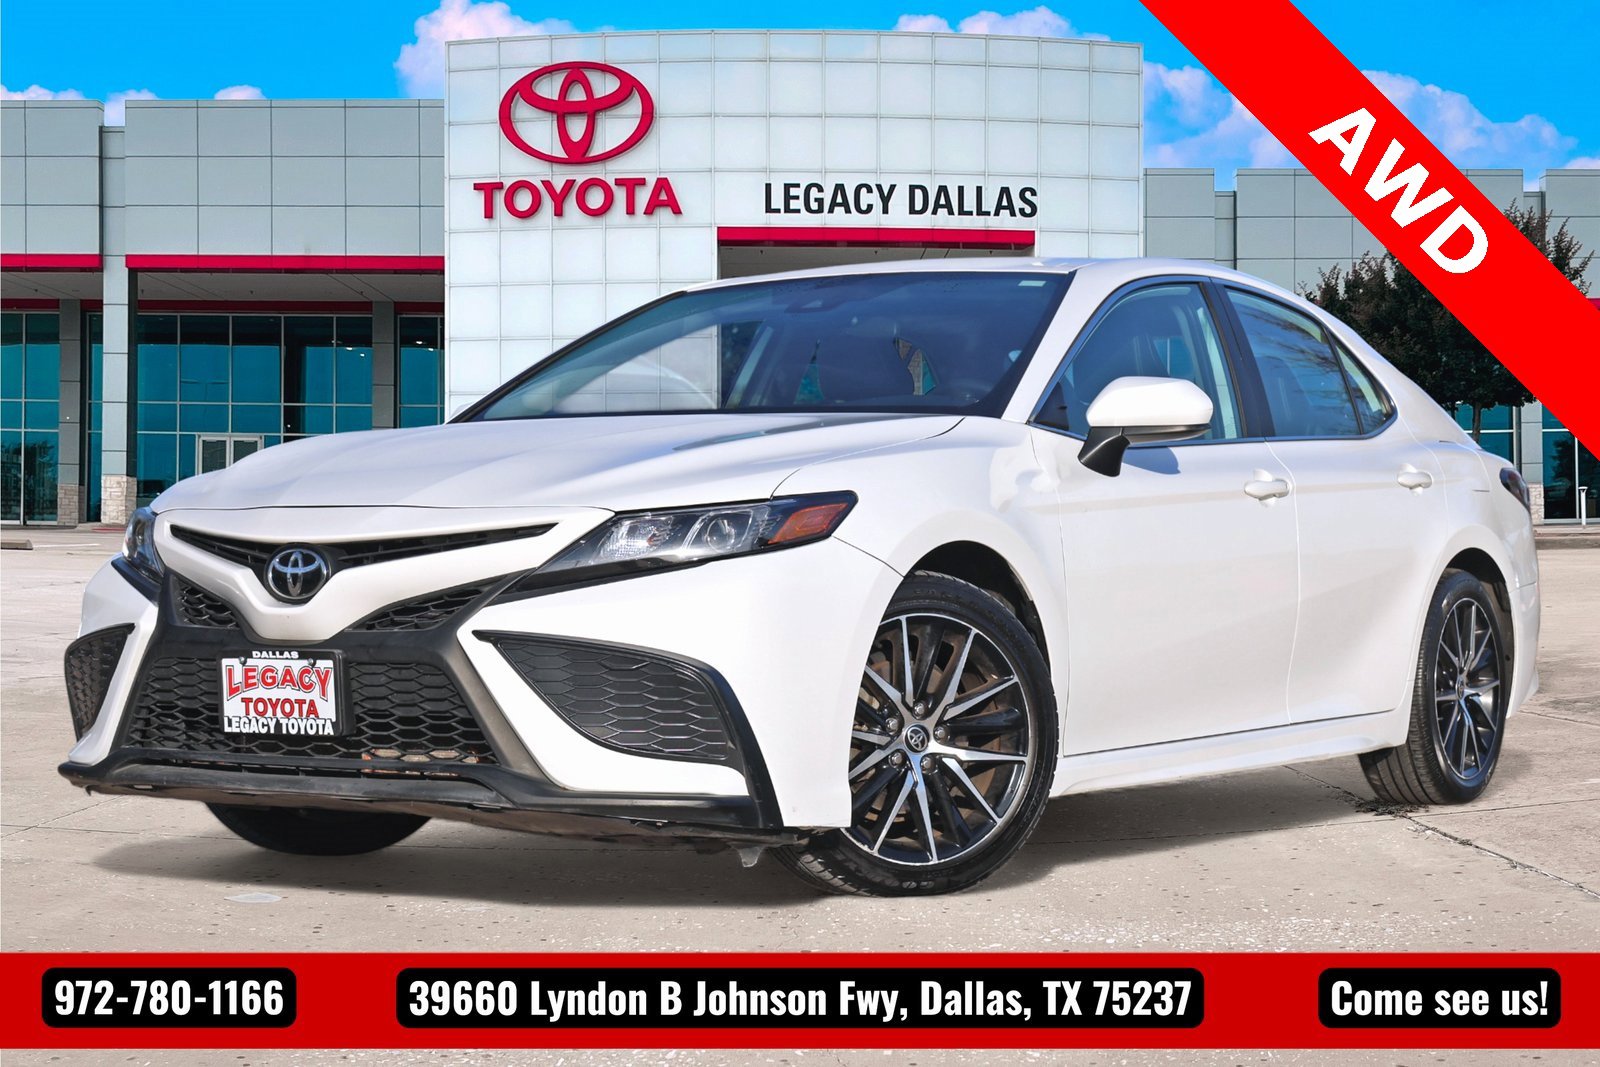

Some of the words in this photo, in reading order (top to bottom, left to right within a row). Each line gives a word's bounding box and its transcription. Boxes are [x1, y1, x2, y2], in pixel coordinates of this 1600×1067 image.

[474, 177, 682, 219] TOYOTA
[764, 182, 897, 215] LEGACY
[908, 184, 1038, 218] DALLAS
[252, 650, 299, 659] DALLAS
[225, 665, 333, 702] LEGACY
[241, 697, 319, 718] TOYOTA
[224, 716, 277, 734] LEGACY
[279, 717, 334, 735] TOYOTA
